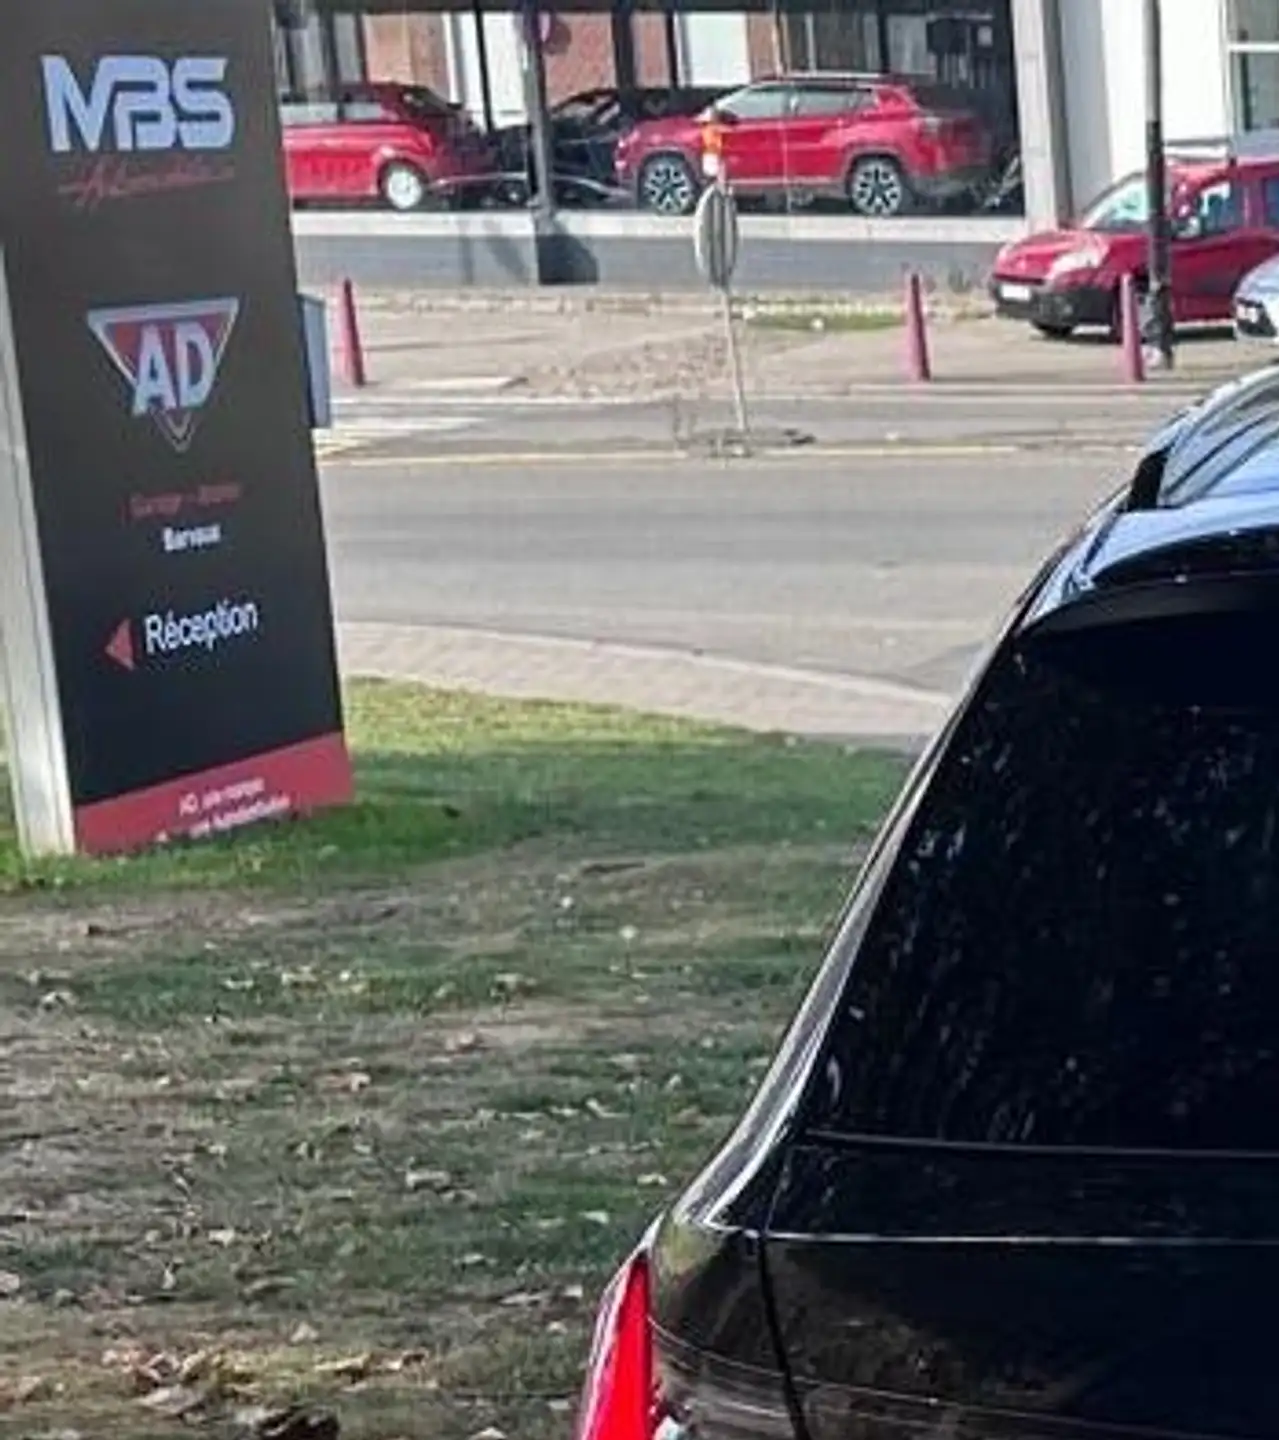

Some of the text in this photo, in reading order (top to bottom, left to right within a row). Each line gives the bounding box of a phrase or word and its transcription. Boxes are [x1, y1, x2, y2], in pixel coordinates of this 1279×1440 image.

[41, 54, 236, 152] MBS
[133, 319, 216, 416] AD
[144, 599, 257, 655] Réception
